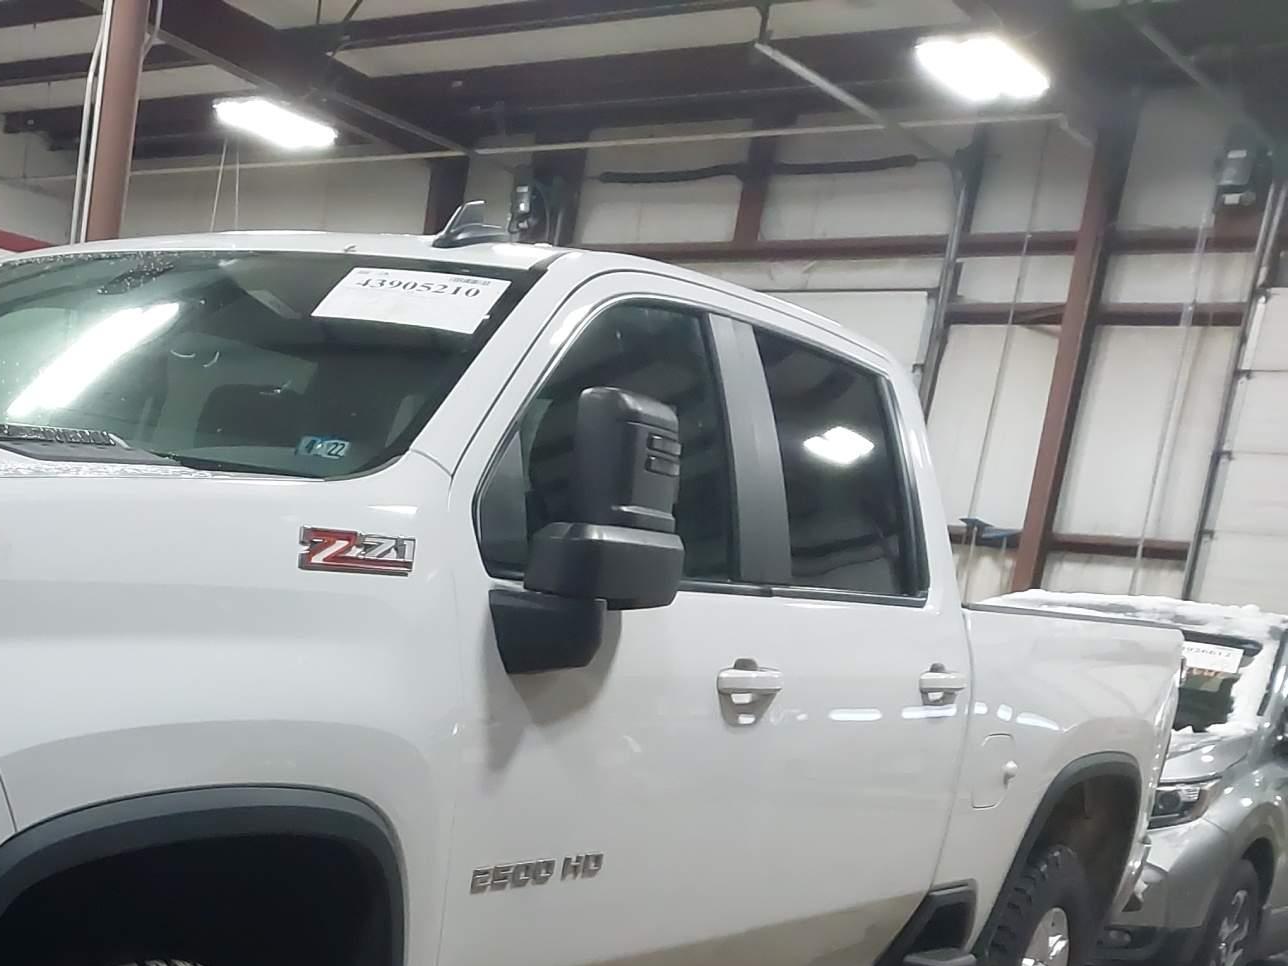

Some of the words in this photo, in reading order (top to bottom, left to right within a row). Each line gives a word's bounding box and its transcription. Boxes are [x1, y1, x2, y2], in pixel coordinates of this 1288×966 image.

[355, 278, 481, 298] 43905210
[327, 441, 346, 457] 22
[298, 524, 416, 577] Z71
[470, 858, 556, 895] 2500
[561, 851, 604, 881] HD
